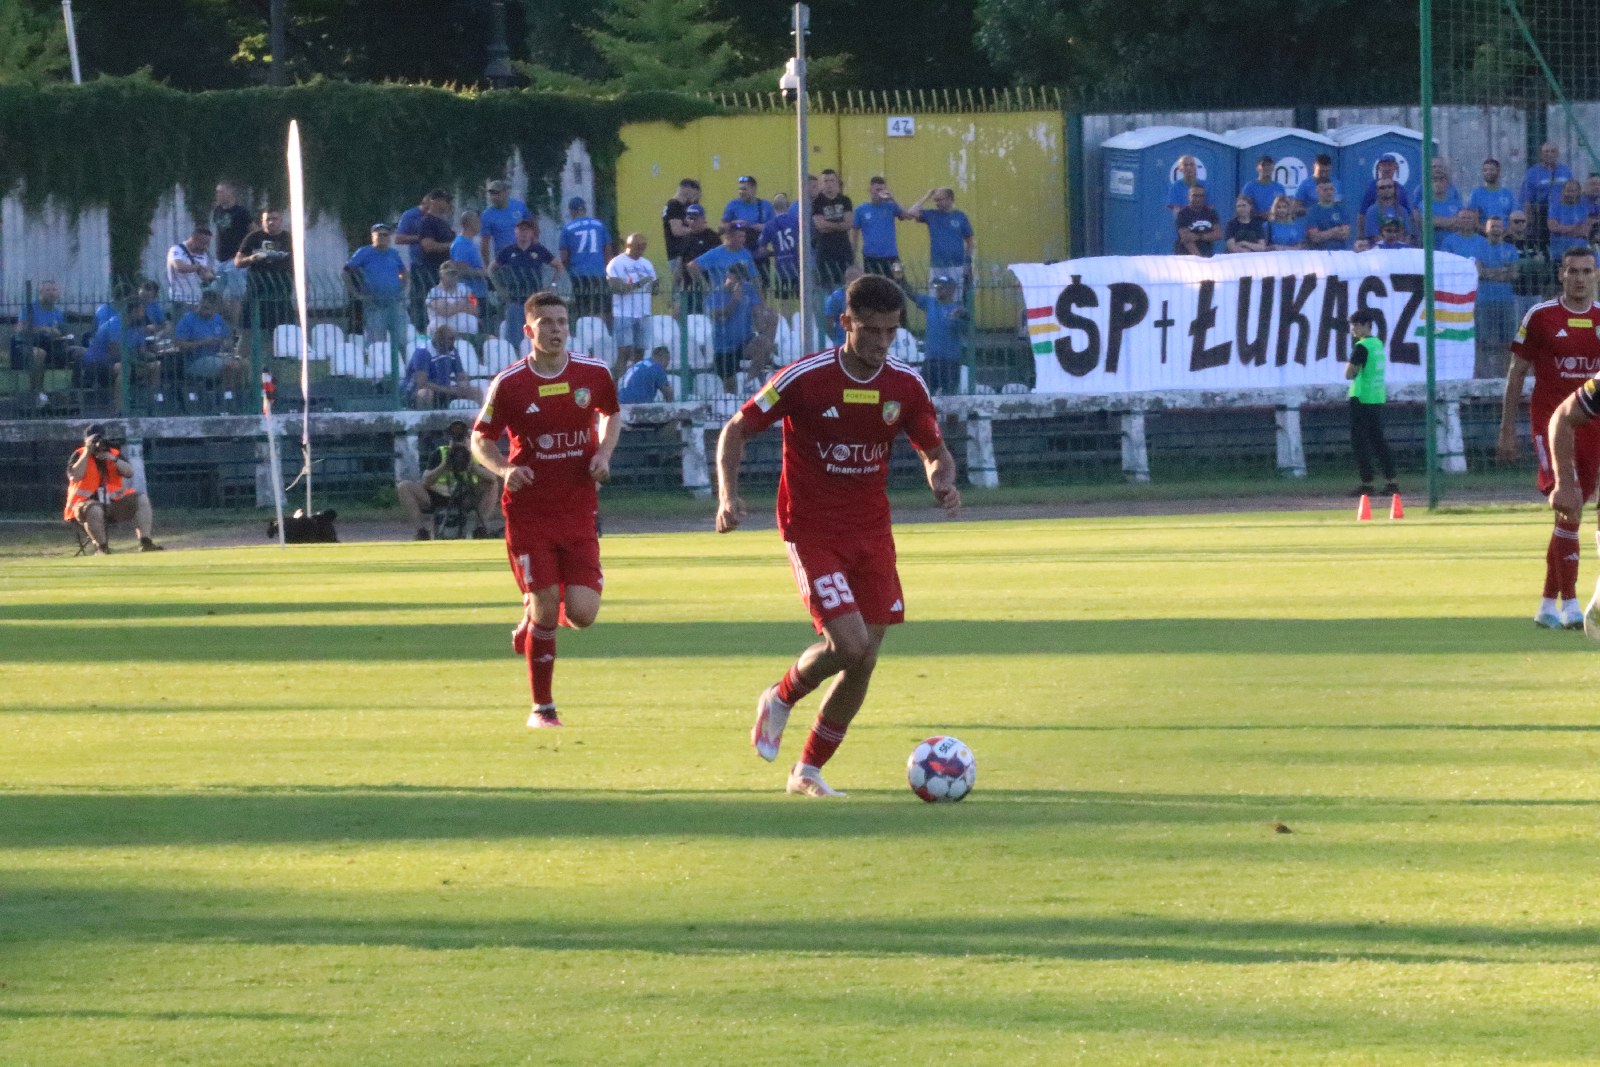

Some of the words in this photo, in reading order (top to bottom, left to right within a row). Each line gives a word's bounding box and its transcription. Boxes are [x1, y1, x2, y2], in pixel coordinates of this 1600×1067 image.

[574, 228, 598, 253] 71
[1188, 273, 1426, 372] ŁUKASZ
[817, 441, 889, 462] VOTUM
[826, 463, 863, 474] Finance
[813, 571, 855, 609] 59
